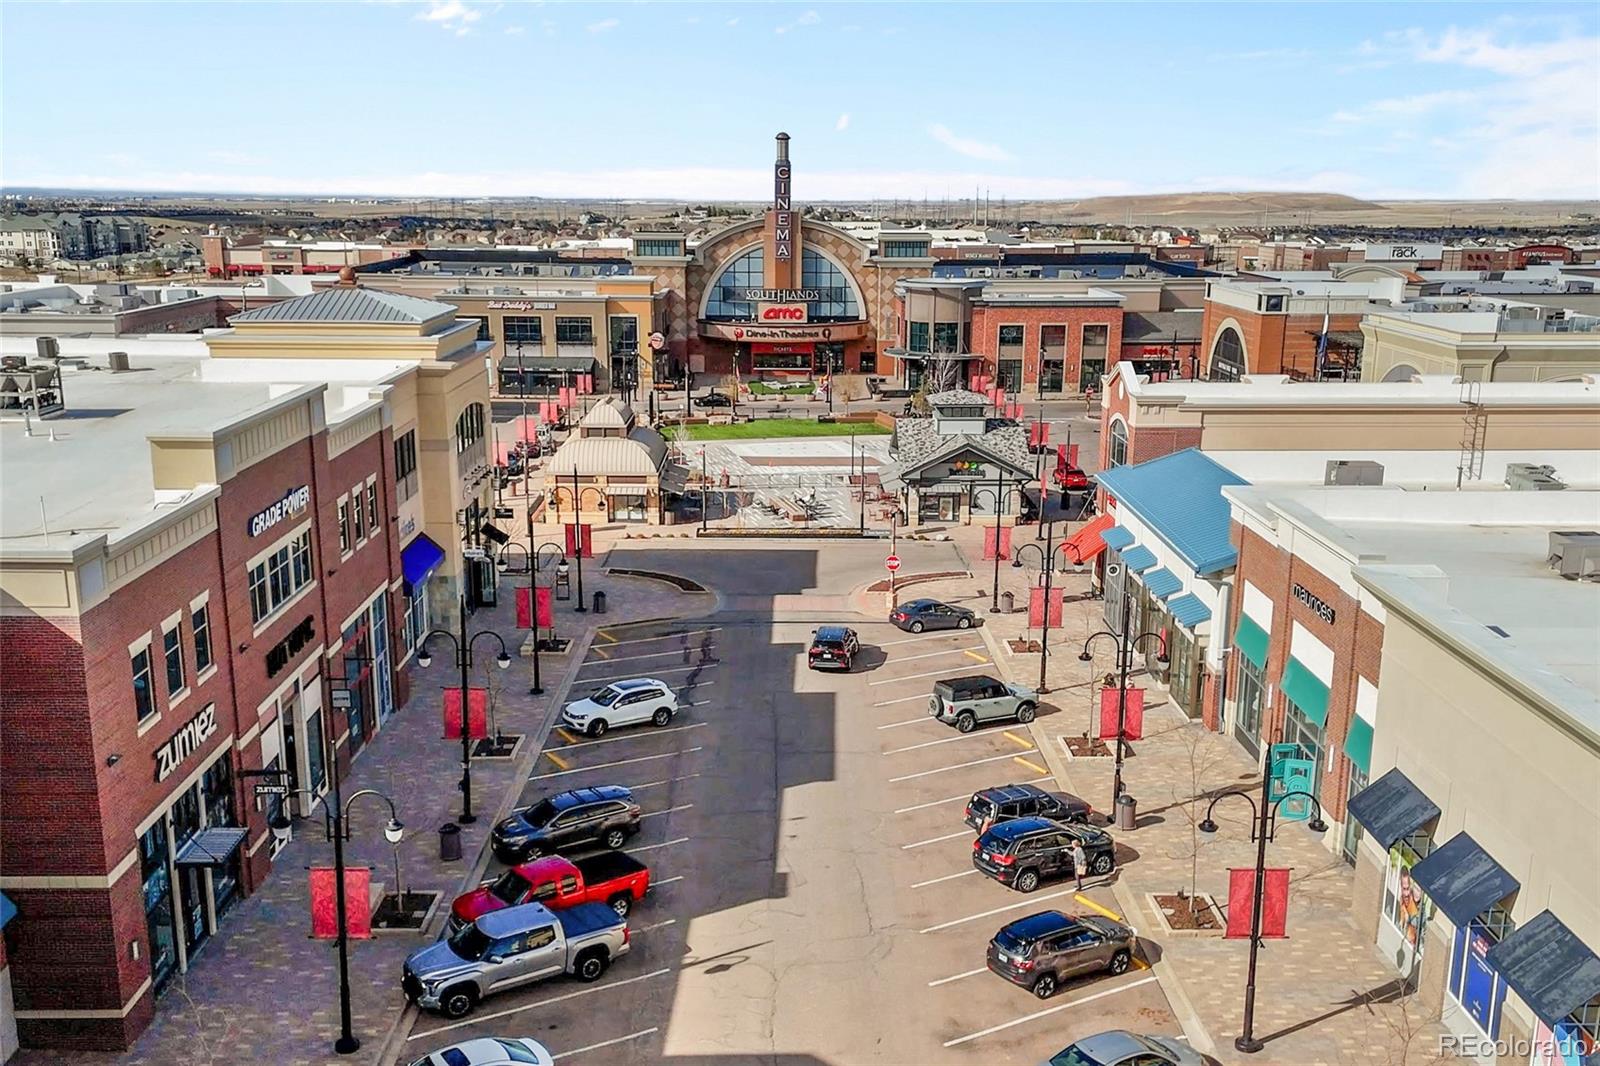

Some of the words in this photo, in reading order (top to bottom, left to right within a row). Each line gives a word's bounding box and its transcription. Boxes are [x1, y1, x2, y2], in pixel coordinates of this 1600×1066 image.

[777, 166, 789, 256] CINEMA
[1392, 246, 1417, 258] rack
[746, 289, 819, 302] SOUTHLANDS
[763, 308, 804, 320] amc
[746, 329, 778, 338] Dine-In
[778, 329, 820, 338] Theatres
[252, 501, 282, 538] GRADE
[283, 485, 310, 518] POWER
